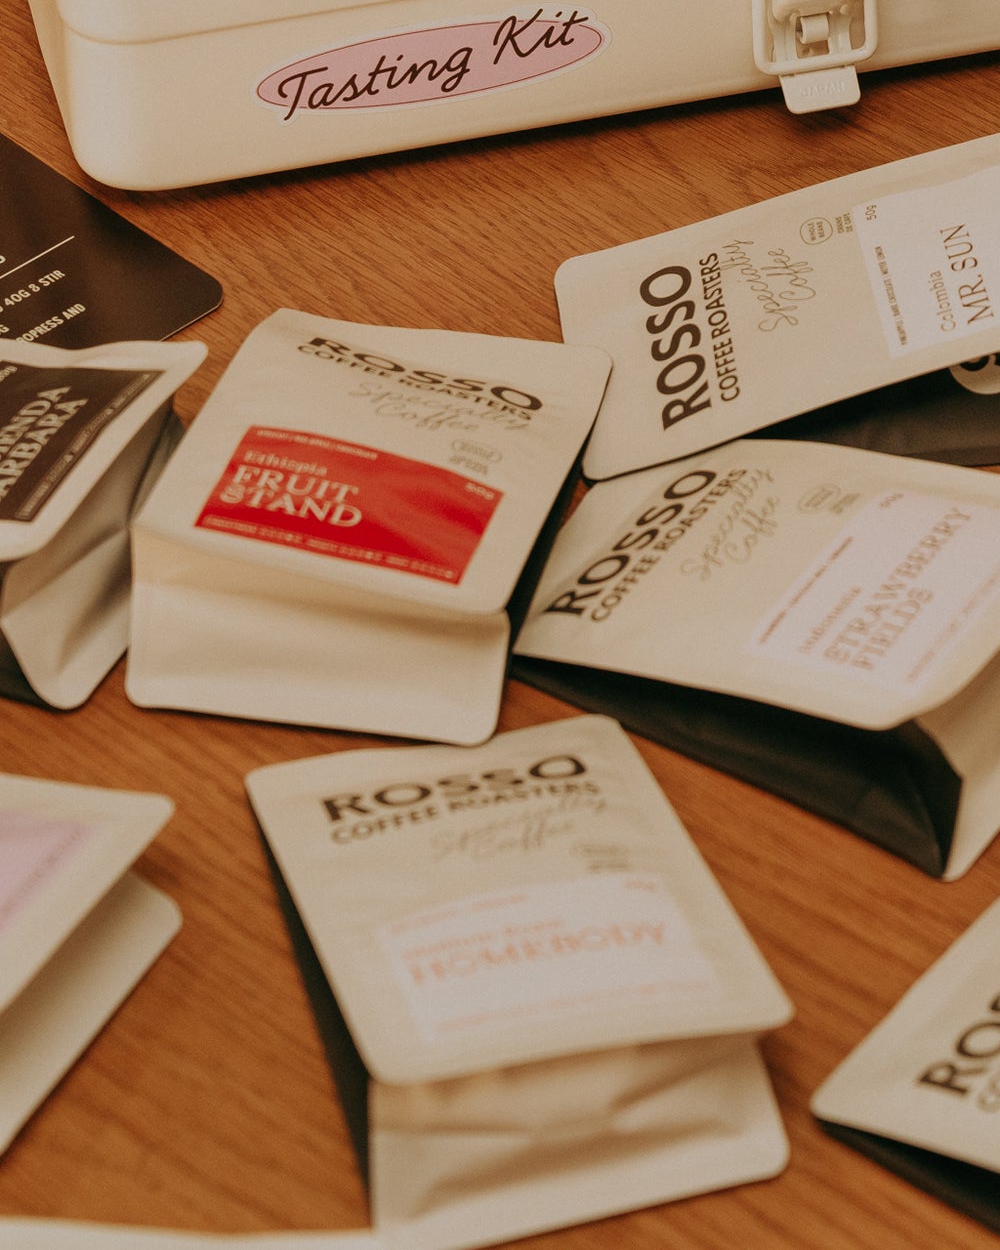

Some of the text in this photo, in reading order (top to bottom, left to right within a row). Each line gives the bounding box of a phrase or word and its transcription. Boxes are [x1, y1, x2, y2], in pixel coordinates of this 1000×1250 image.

[277, 8, 589, 121] Tasting Kit
[865, 204, 877, 221] 50g
[761, 248, 817, 301] Coffee
[940, 223, 978, 272] SUN
[4, 289, 31, 306] 40G
[38, 270, 66, 287] STIR
[62, 303, 86, 320] AND
[720, 240, 799, 332] Specialty
[928, 270, 957, 332] Colombia
[958, 274, 995, 325] MR.
[639, 265, 713, 431] ROSSO
[699, 253, 740, 402] COFFEE ROASTERS
[298, 344, 532, 421] COFFEE ROASTERS
[308, 337, 543, 411] ROSSO
[232, 464, 359, 503] FRUIT
[244, 450, 328, 476] Ethiopia
[220, 482, 363, 527] STAND
[545, 470, 717, 616] ROSSO
[590, 469, 747, 622] COFFEE ROASTERS
[321, 754, 586, 822] ROSSO
